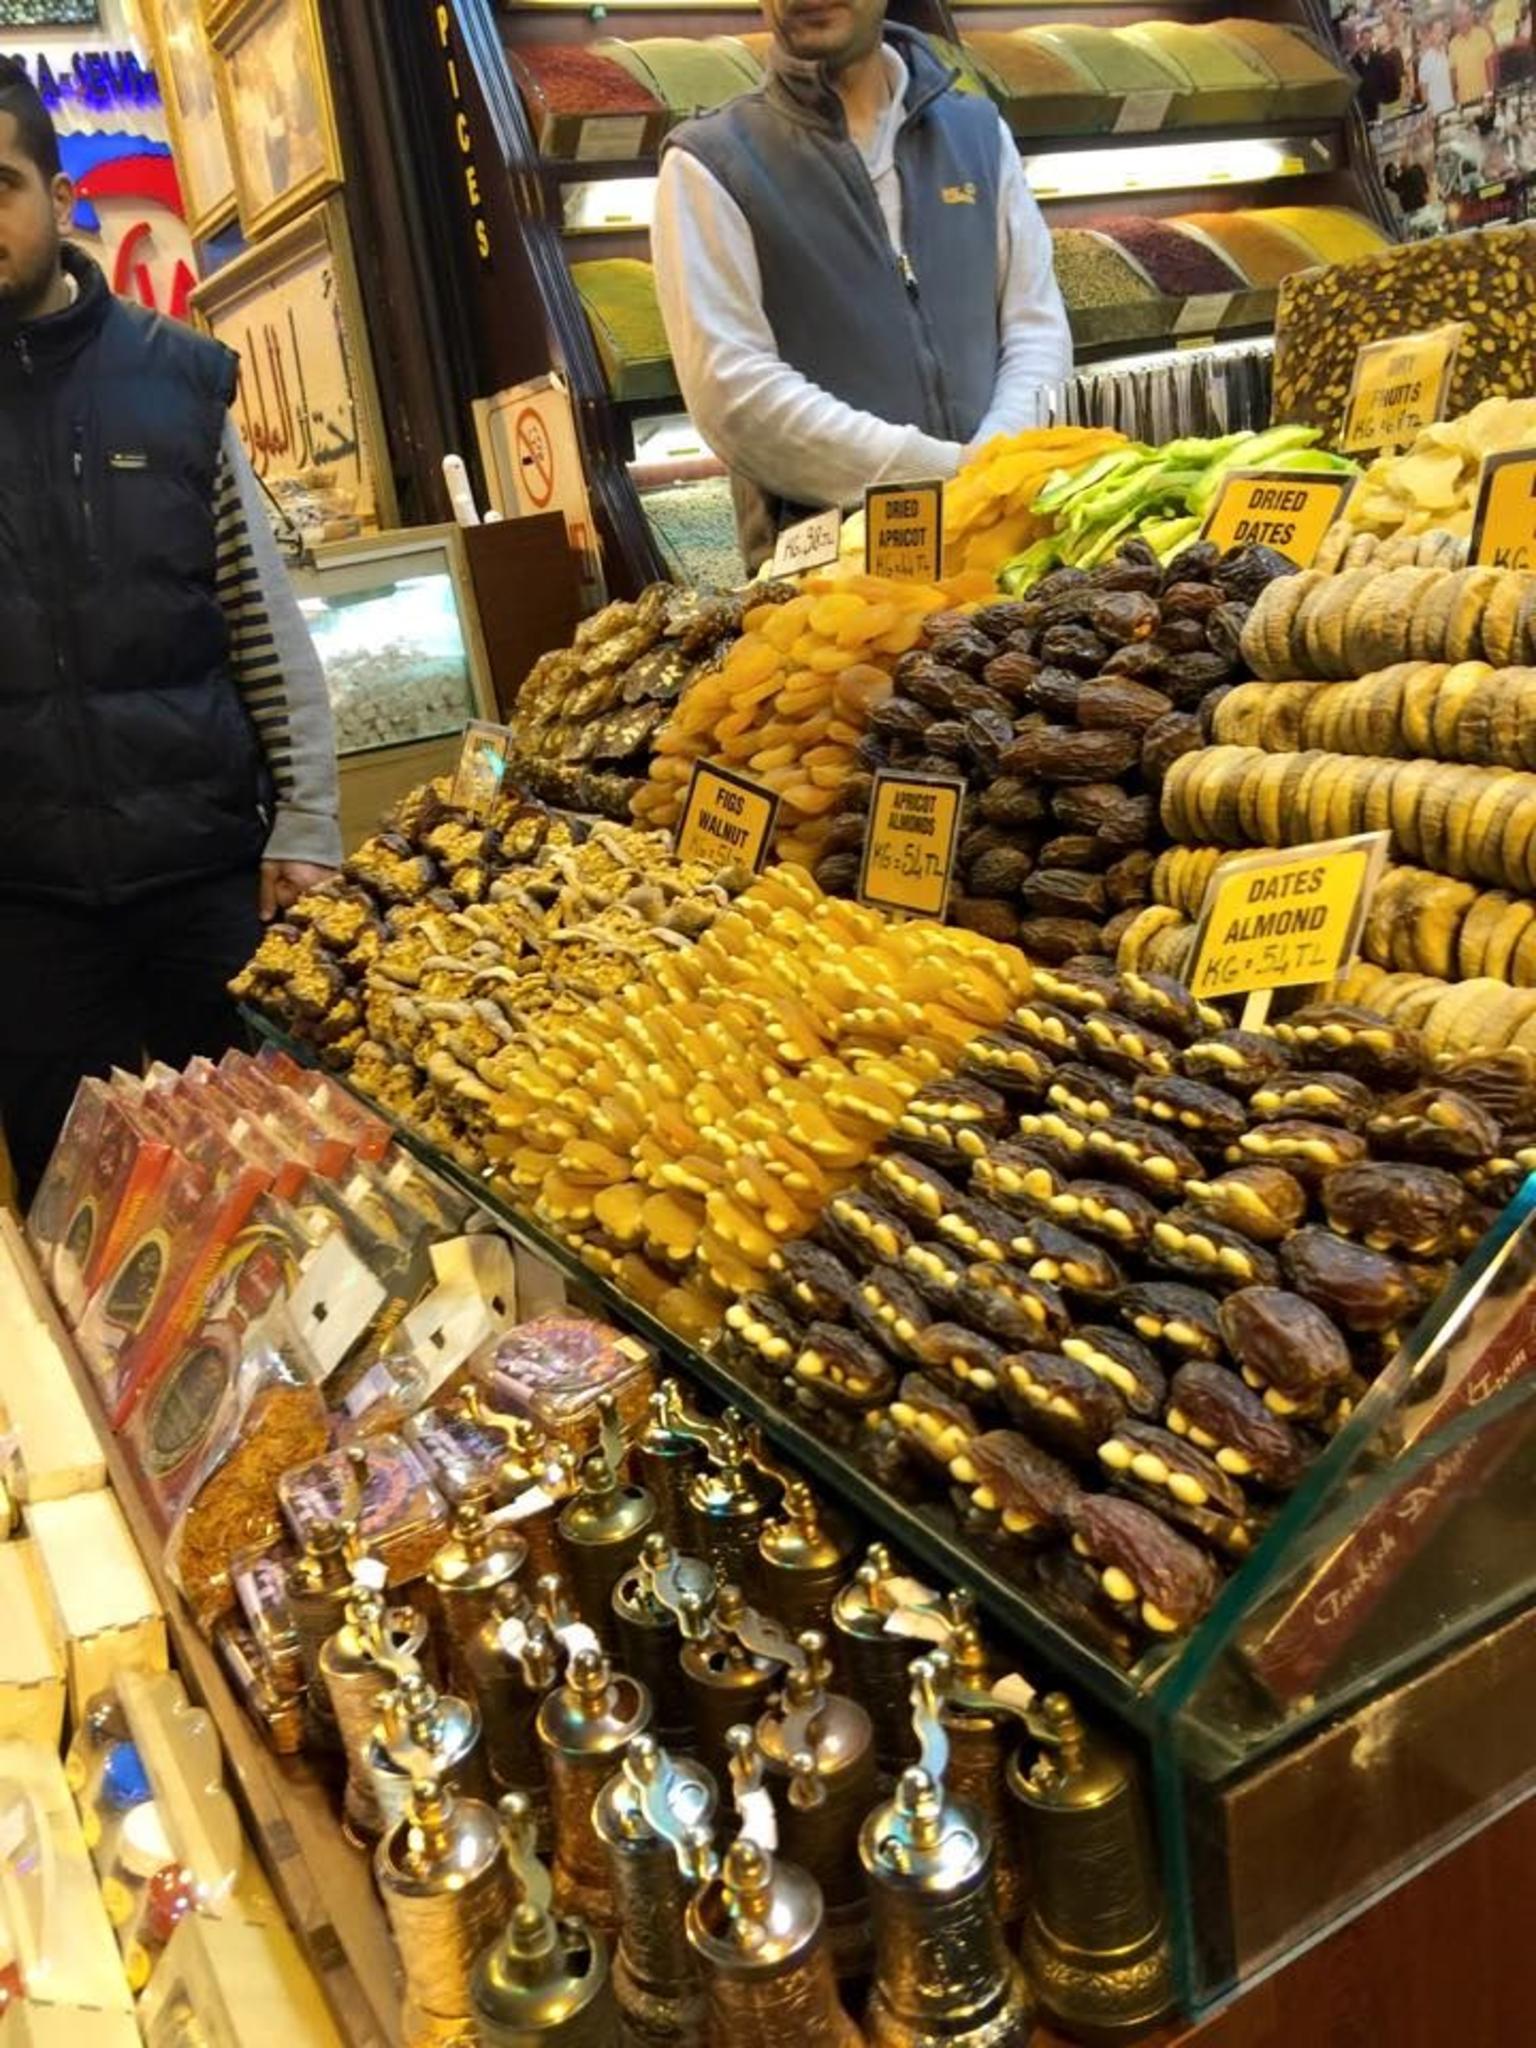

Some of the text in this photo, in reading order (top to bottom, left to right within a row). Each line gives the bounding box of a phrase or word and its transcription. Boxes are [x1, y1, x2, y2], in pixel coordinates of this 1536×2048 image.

[886, 499, 919, 519] DRIED
[1248, 488, 1308, 512] DRIED
[878, 527, 926, 549] APRICOT
[1232, 519, 1296, 545] DATES
[716, 787, 745, 816] FIGS
[894, 791, 937, 813] APRICOT
[699, 808, 749, 848] WALNUT
[1248, 866, 1325, 903] DATES
[1223, 904, 1328, 944] ALMOND
